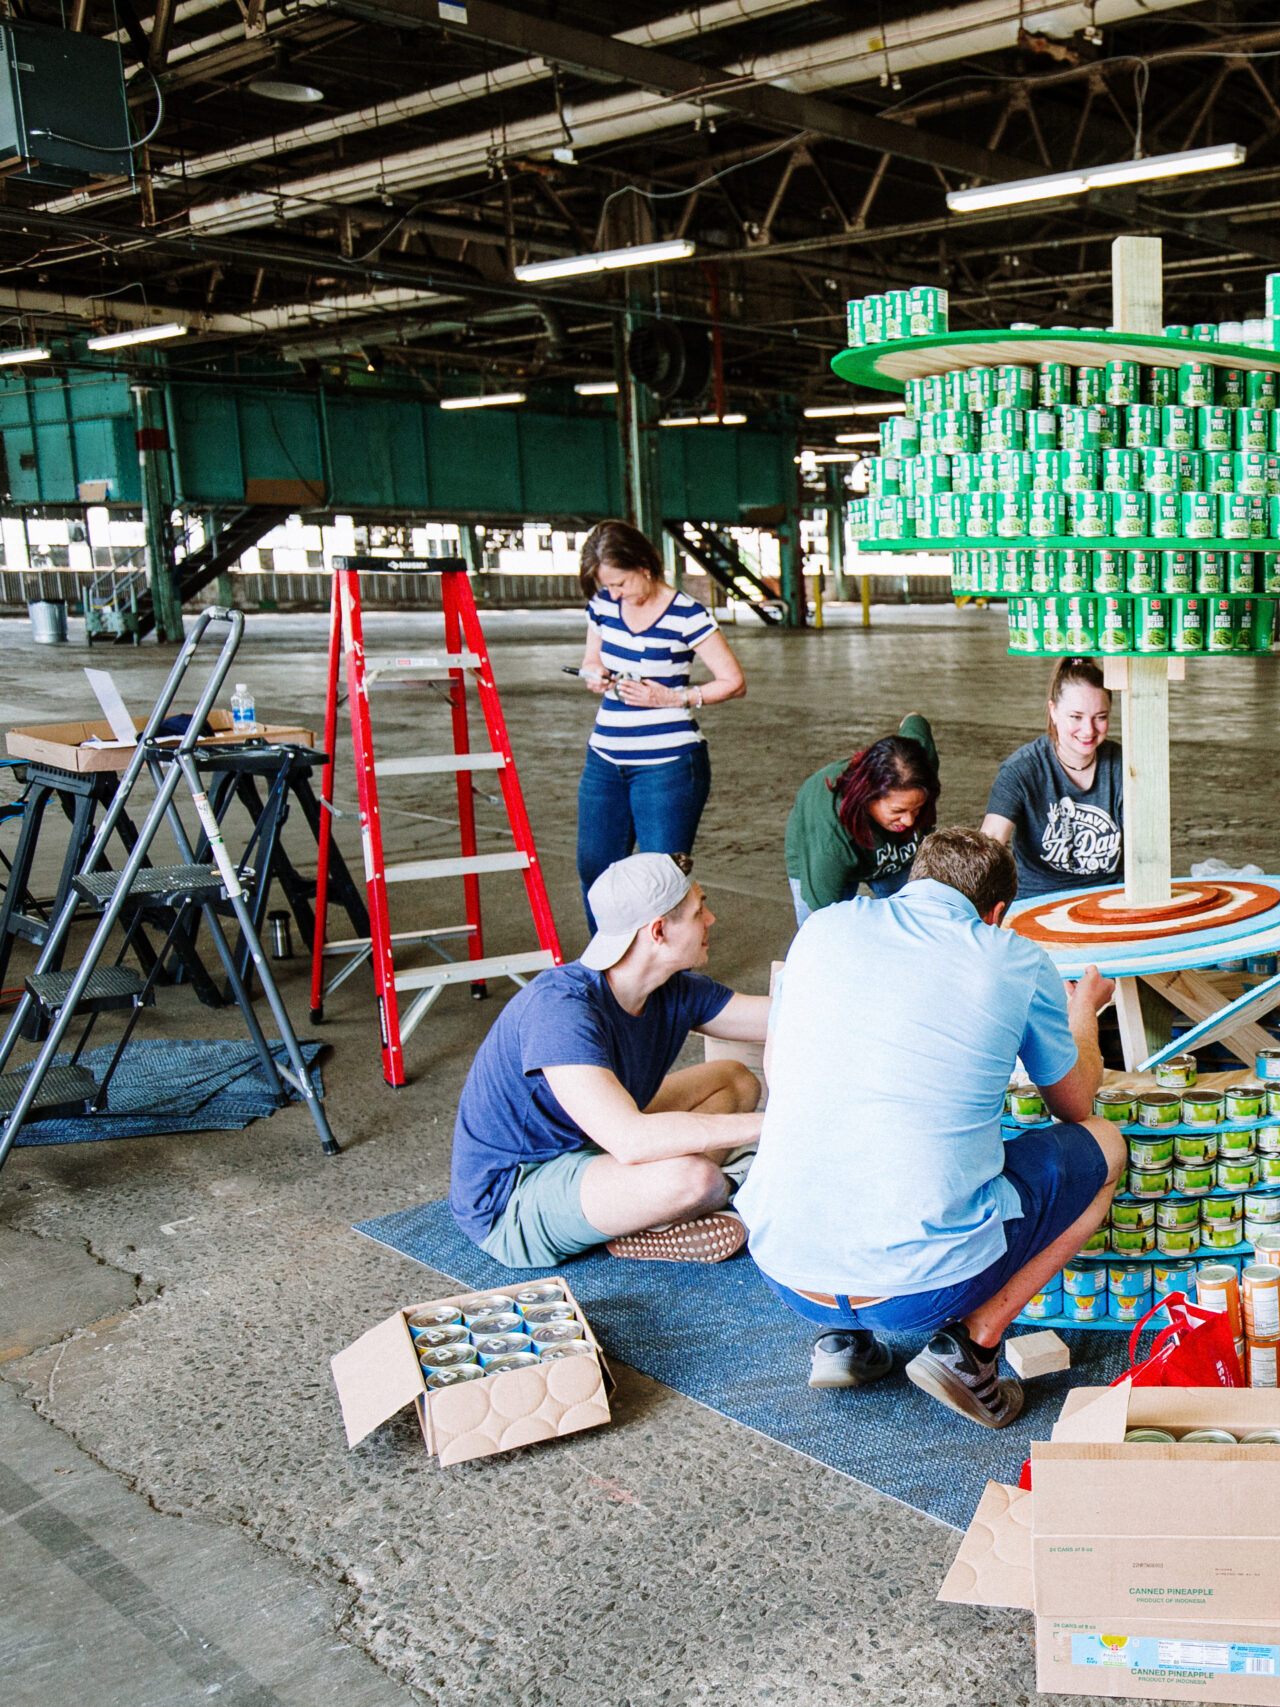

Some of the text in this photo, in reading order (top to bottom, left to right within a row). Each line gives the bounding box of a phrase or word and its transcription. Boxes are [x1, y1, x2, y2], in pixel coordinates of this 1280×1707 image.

[1075, 811, 1110, 833] HAVE
[1073, 830, 1121, 858] Day
[1077, 857, 1109, 871] YOU
[1167, 1588, 1213, 1596] PINEAPPLE
[1131, 1668, 1214, 1679] CANNED PINEAPPLE
